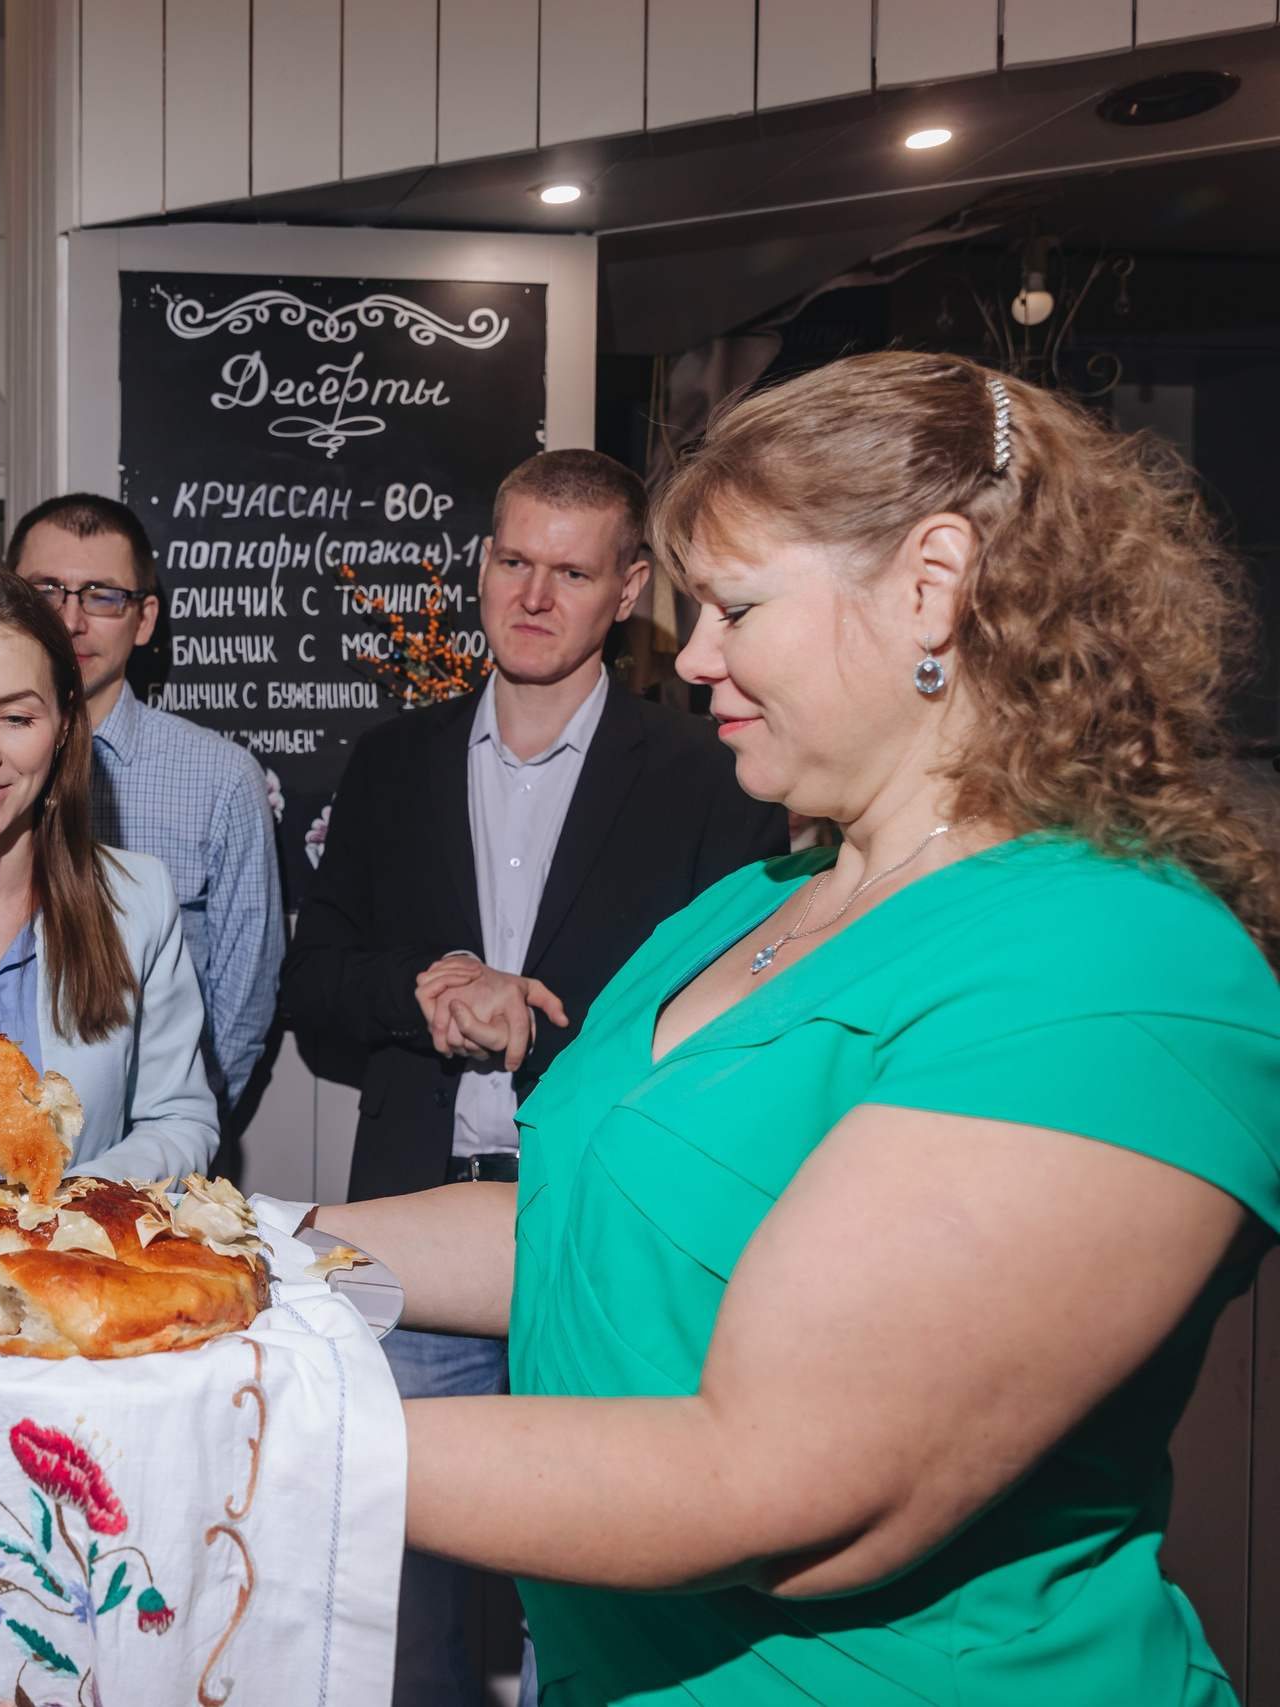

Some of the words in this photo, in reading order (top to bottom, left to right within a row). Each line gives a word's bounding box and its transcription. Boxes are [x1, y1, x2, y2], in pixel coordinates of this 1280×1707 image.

[210, 351, 451, 432] Десерты
[173, 481, 353, 520] КРУАССАН
[170, 584, 288, 619] БЛИНЧИК
[172, 634, 279, 666] БЛИНЧИК
[341, 631, 424, 661] МЯС
[147, 682, 240, 712] БЛИНЧИК
